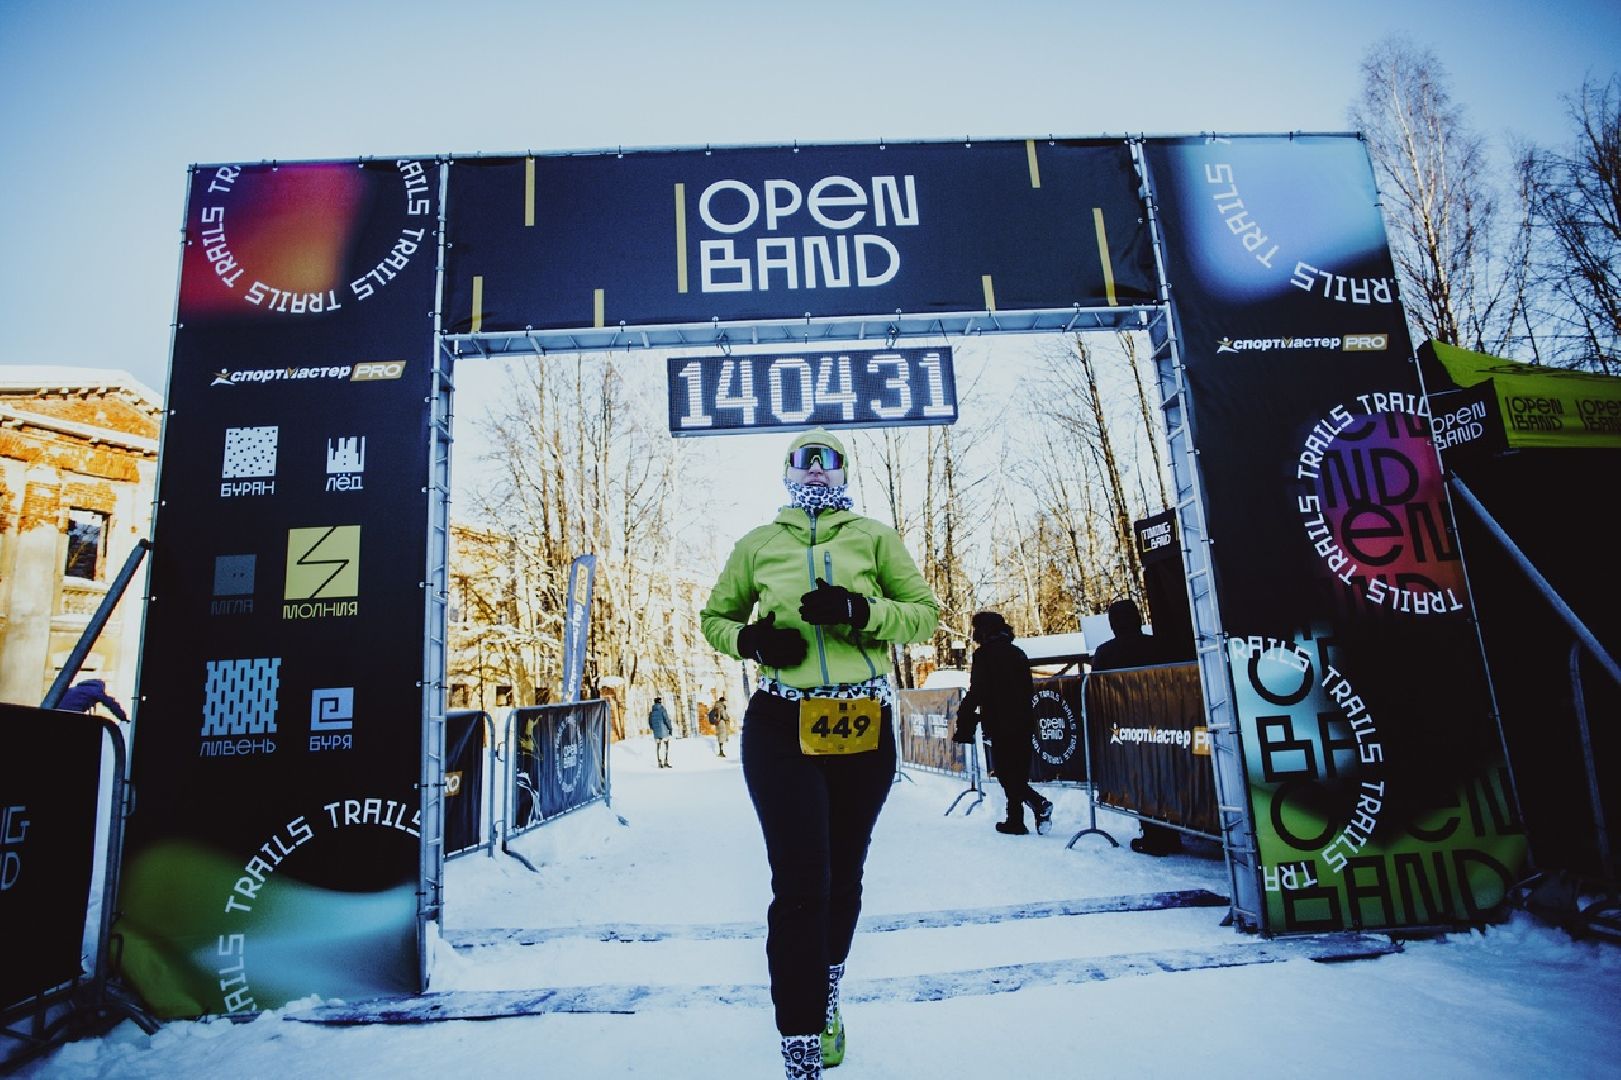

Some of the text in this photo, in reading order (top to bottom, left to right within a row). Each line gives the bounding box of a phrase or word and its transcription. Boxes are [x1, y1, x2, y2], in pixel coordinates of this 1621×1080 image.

[1204, 163, 1280, 268] TRAILS
[201, 206, 245, 288] TRAILS
[350, 228, 424, 300] TRAILS
[700, 234, 900, 293] BAND
[245, 281, 342, 314] TRAILS
[1290, 261, 1395, 305] RAILS
[1345, 336, 1386, 348] PRO
[354, 363, 402, 379] PRO
[1357, 392, 1430, 416] TRAIL
[1514, 414, 1562, 431] BAND
[1298, 404, 1355, 479] TRAILS
[220, 481, 275, 497] БУРАН
[1299, 495, 1357, 585] TRAILS
[282, 602, 358, 620] МОЛНИЯ
[1366, 578, 1463, 615] TRAILS
[811, 715, 871, 738] 449
[1321, 665, 1384, 763] TRAILS
[309, 734, 353, 751] БУРЯ
[1322, 781, 1385, 873] TRAILS
[225, 816, 313, 913] TRAILS
[1258, 862, 1318, 891] TRA
[219, 934, 255, 1013] AILS
